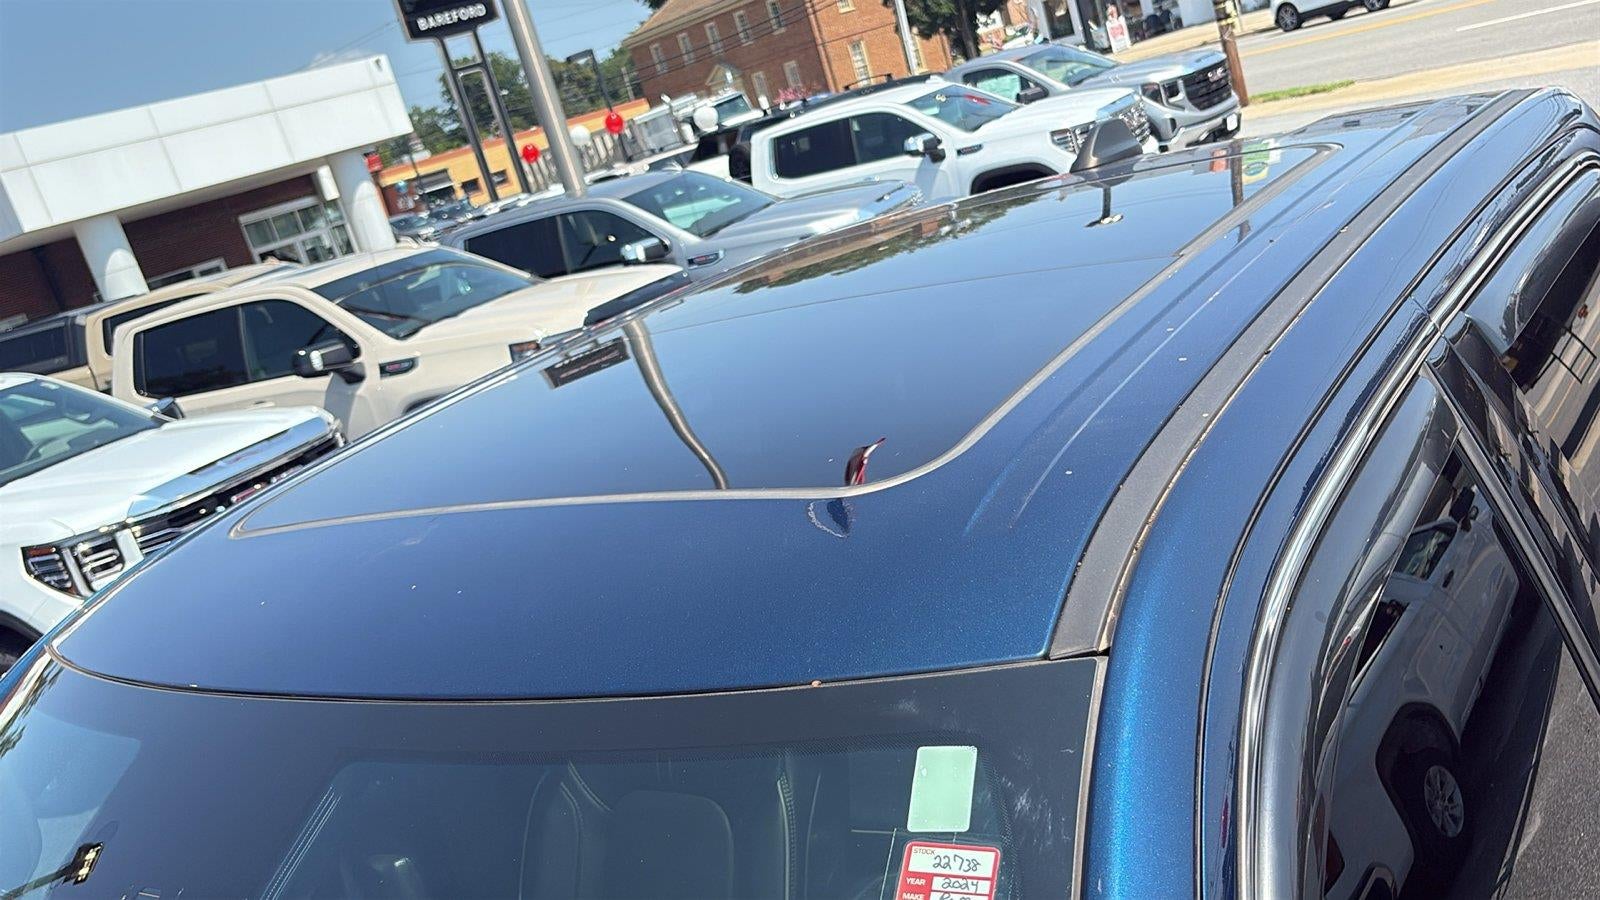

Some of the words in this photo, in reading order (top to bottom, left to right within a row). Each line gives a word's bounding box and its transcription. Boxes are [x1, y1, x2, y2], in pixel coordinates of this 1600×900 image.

[417, 3, 486, 31] BAREFORD
[933, 854, 981, 872] 22738
[906, 877, 926, 886] YEAR
[942, 877, 979, 893] 2024
[902, 892, 925, 900] MAKE
